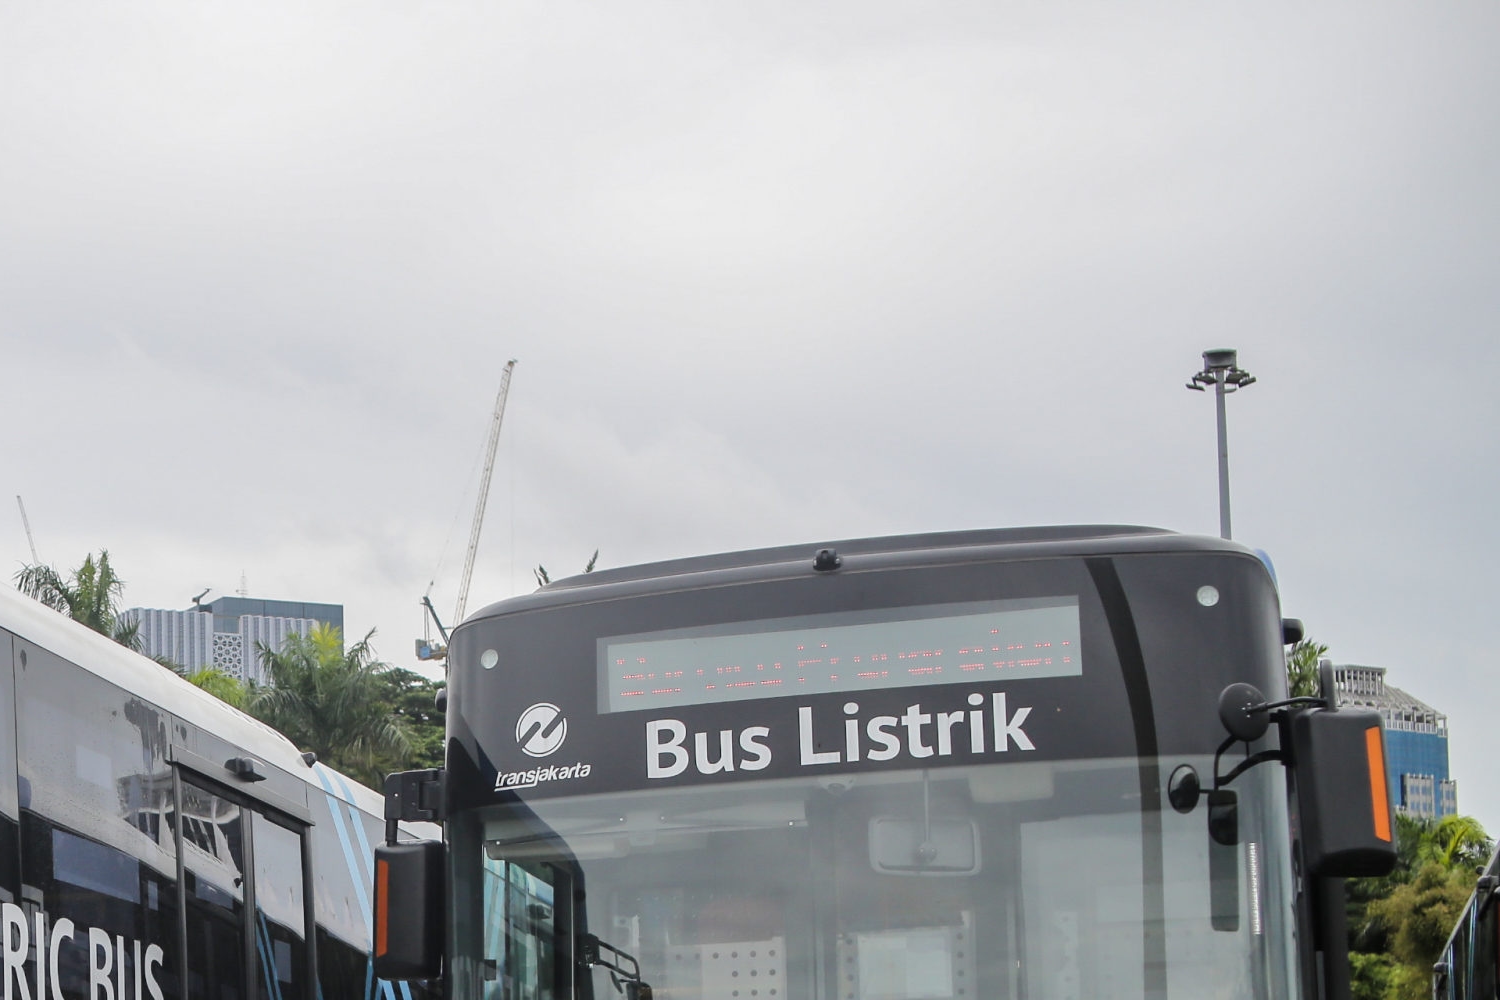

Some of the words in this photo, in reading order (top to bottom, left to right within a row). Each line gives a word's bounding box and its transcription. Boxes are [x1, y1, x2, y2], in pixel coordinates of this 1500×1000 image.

[646, 718, 772, 779] Bus
[798, 692, 1036, 766] Listrik
[494, 762, 592, 792] transjakarta
